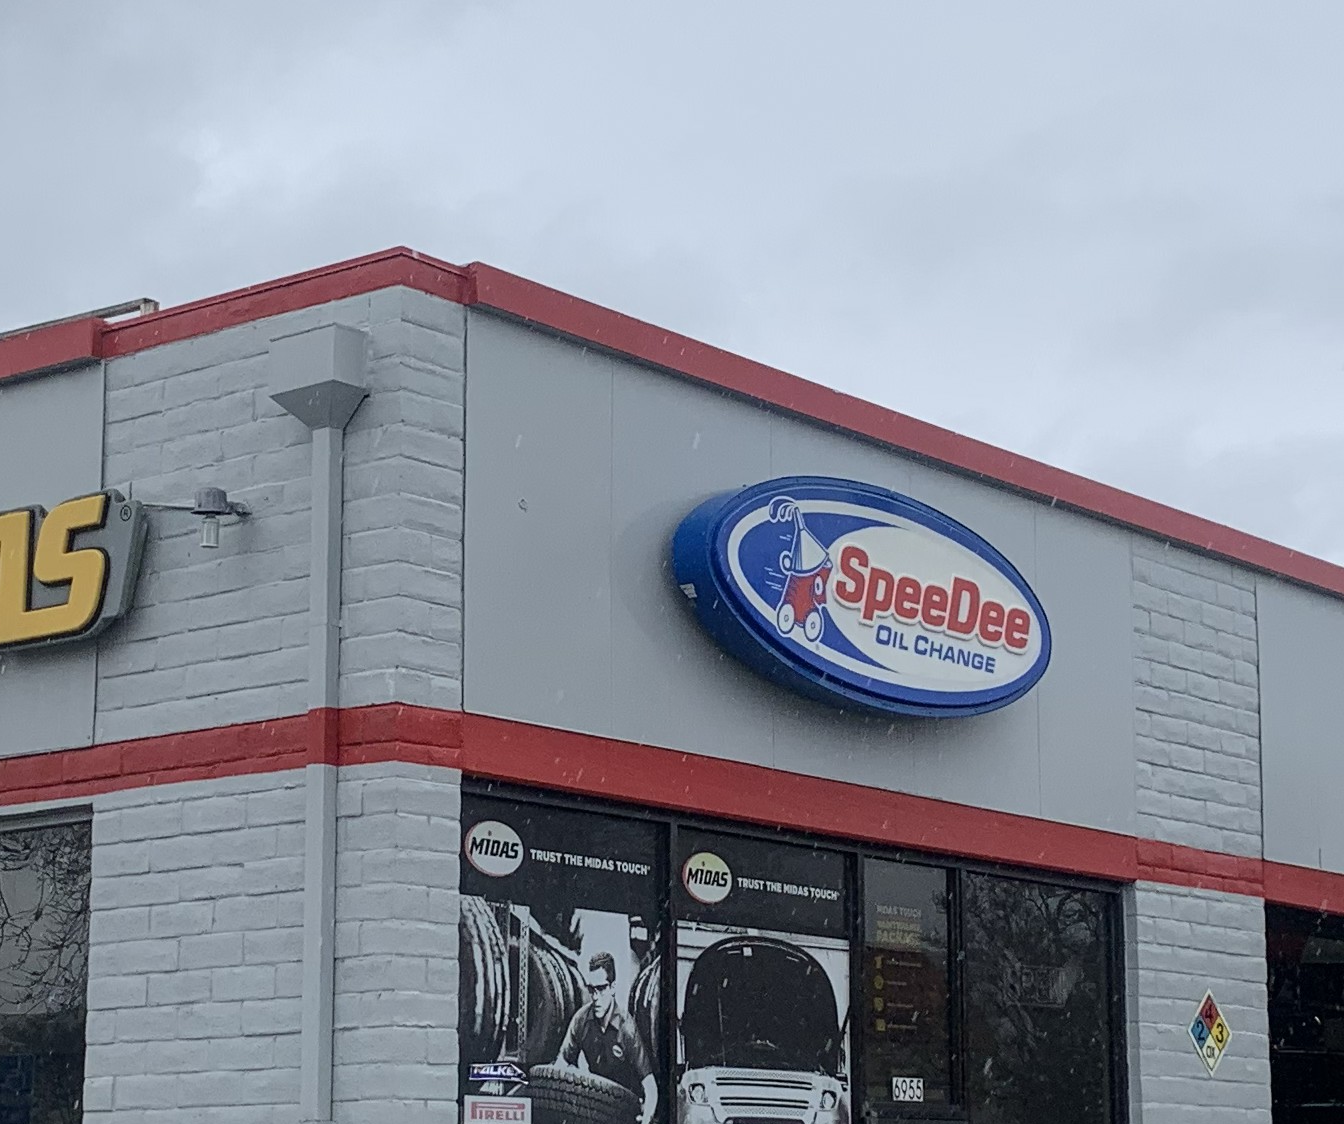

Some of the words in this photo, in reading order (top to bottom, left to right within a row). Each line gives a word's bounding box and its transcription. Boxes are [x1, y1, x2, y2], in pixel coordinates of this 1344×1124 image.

[835, 545, 1031, 650] SpeeDee
[875, 624, 909, 651] OIL
[914, 634, 996, 674] CHANGE
[469, 836, 520, 860] MIDAS
[530, 848, 563, 864] TRUST
[564, 854, 583, 867] THE
[584, 856, 615, 872] MIDAS
[686, 867, 729, 888] MIDAS
[736, 876, 764, 891] TRUST
[765, 880, 782, 893] THE
[783, 883, 809, 897] MIDAS
[1204, 1003, 1214, 1019] 4
[1196, 1020, 1205, 1041] 2
[1215, 1022, 1224, 1043] 3
[893, 1078, 923, 1100] 6955
[470, 1101, 526, 1121] PIRELLI
